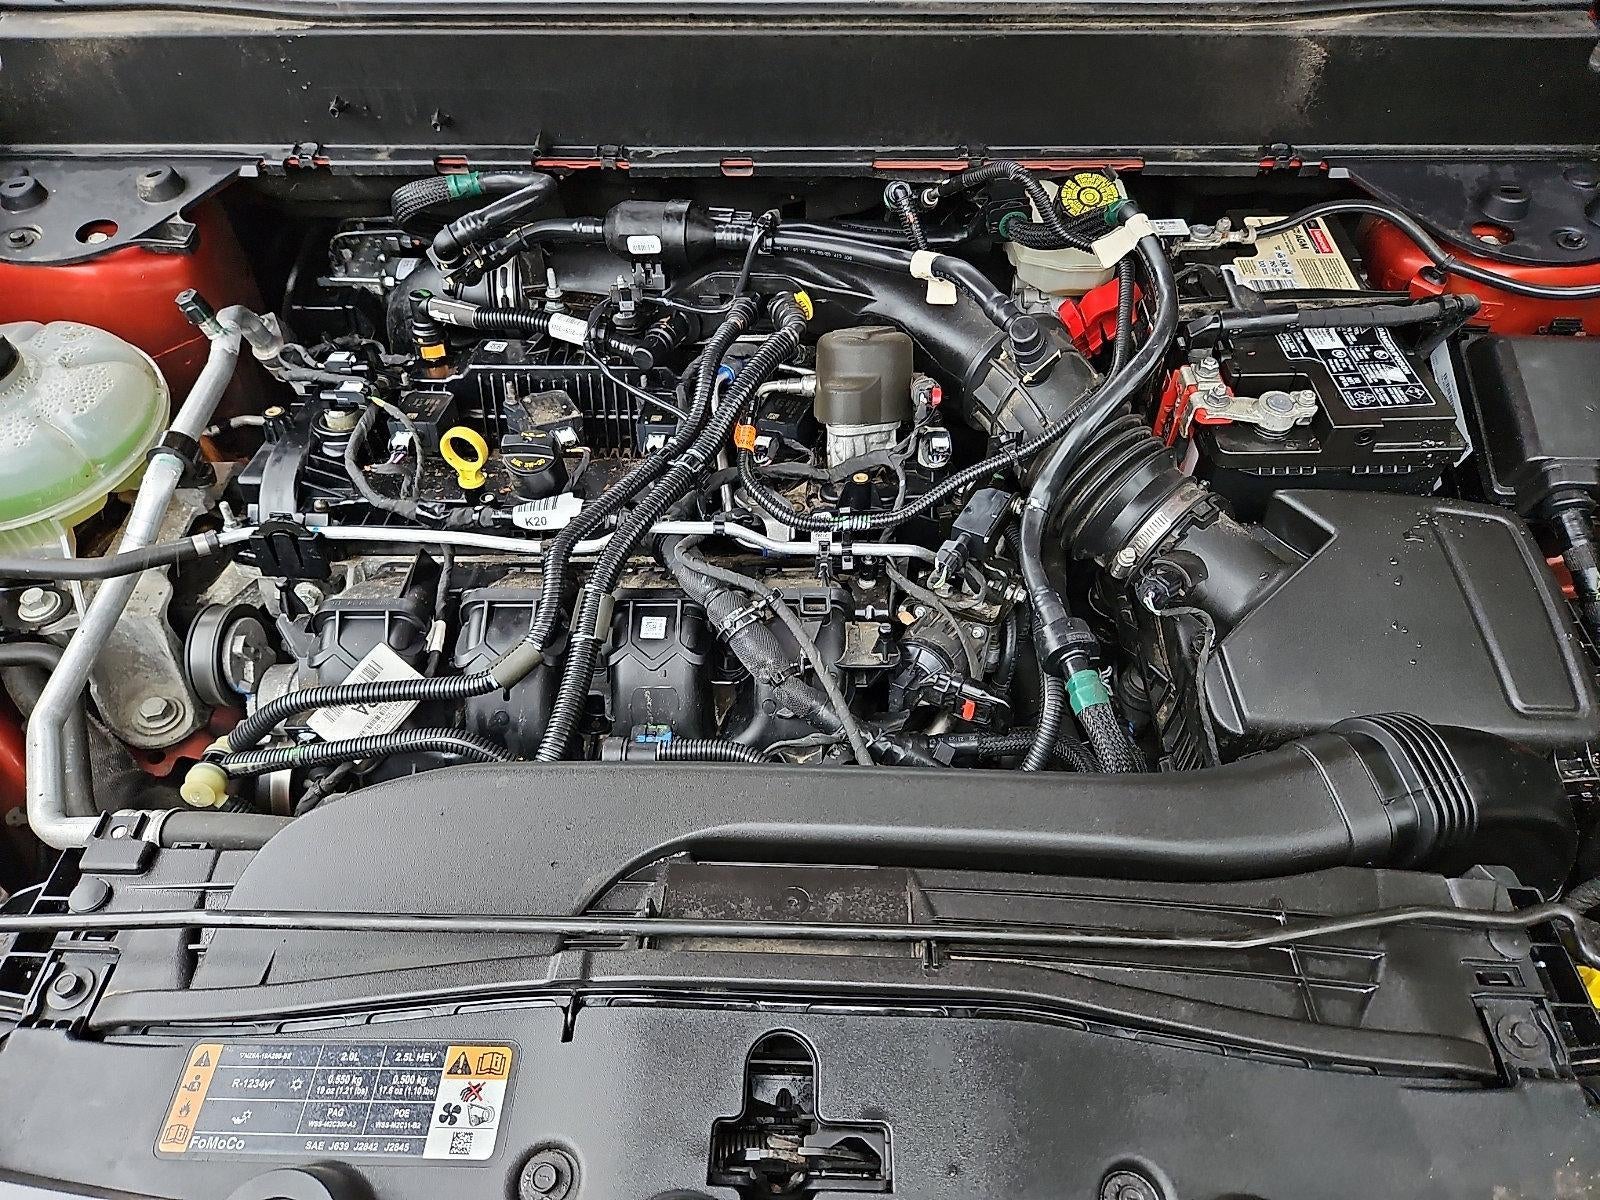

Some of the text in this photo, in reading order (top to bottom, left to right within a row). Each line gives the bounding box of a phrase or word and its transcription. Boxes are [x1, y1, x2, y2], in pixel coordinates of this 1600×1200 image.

[525, 516, 547, 527] K20
[340, 1051, 360, 1062] 2.0L
[395, 1052, 437, 1062] 2.5L HEV
[231, 1078, 275, 1091] R-1234yf
[352, 1074, 363, 1086] kg
[392, 1074, 428, 1086] 0.500 kg
[327, 1107, 345, 1117] PAG
[189, 1136, 245, 1150] FoMoCo
[305, 1140, 410, 1152] SAE J639 J2842 J2845
